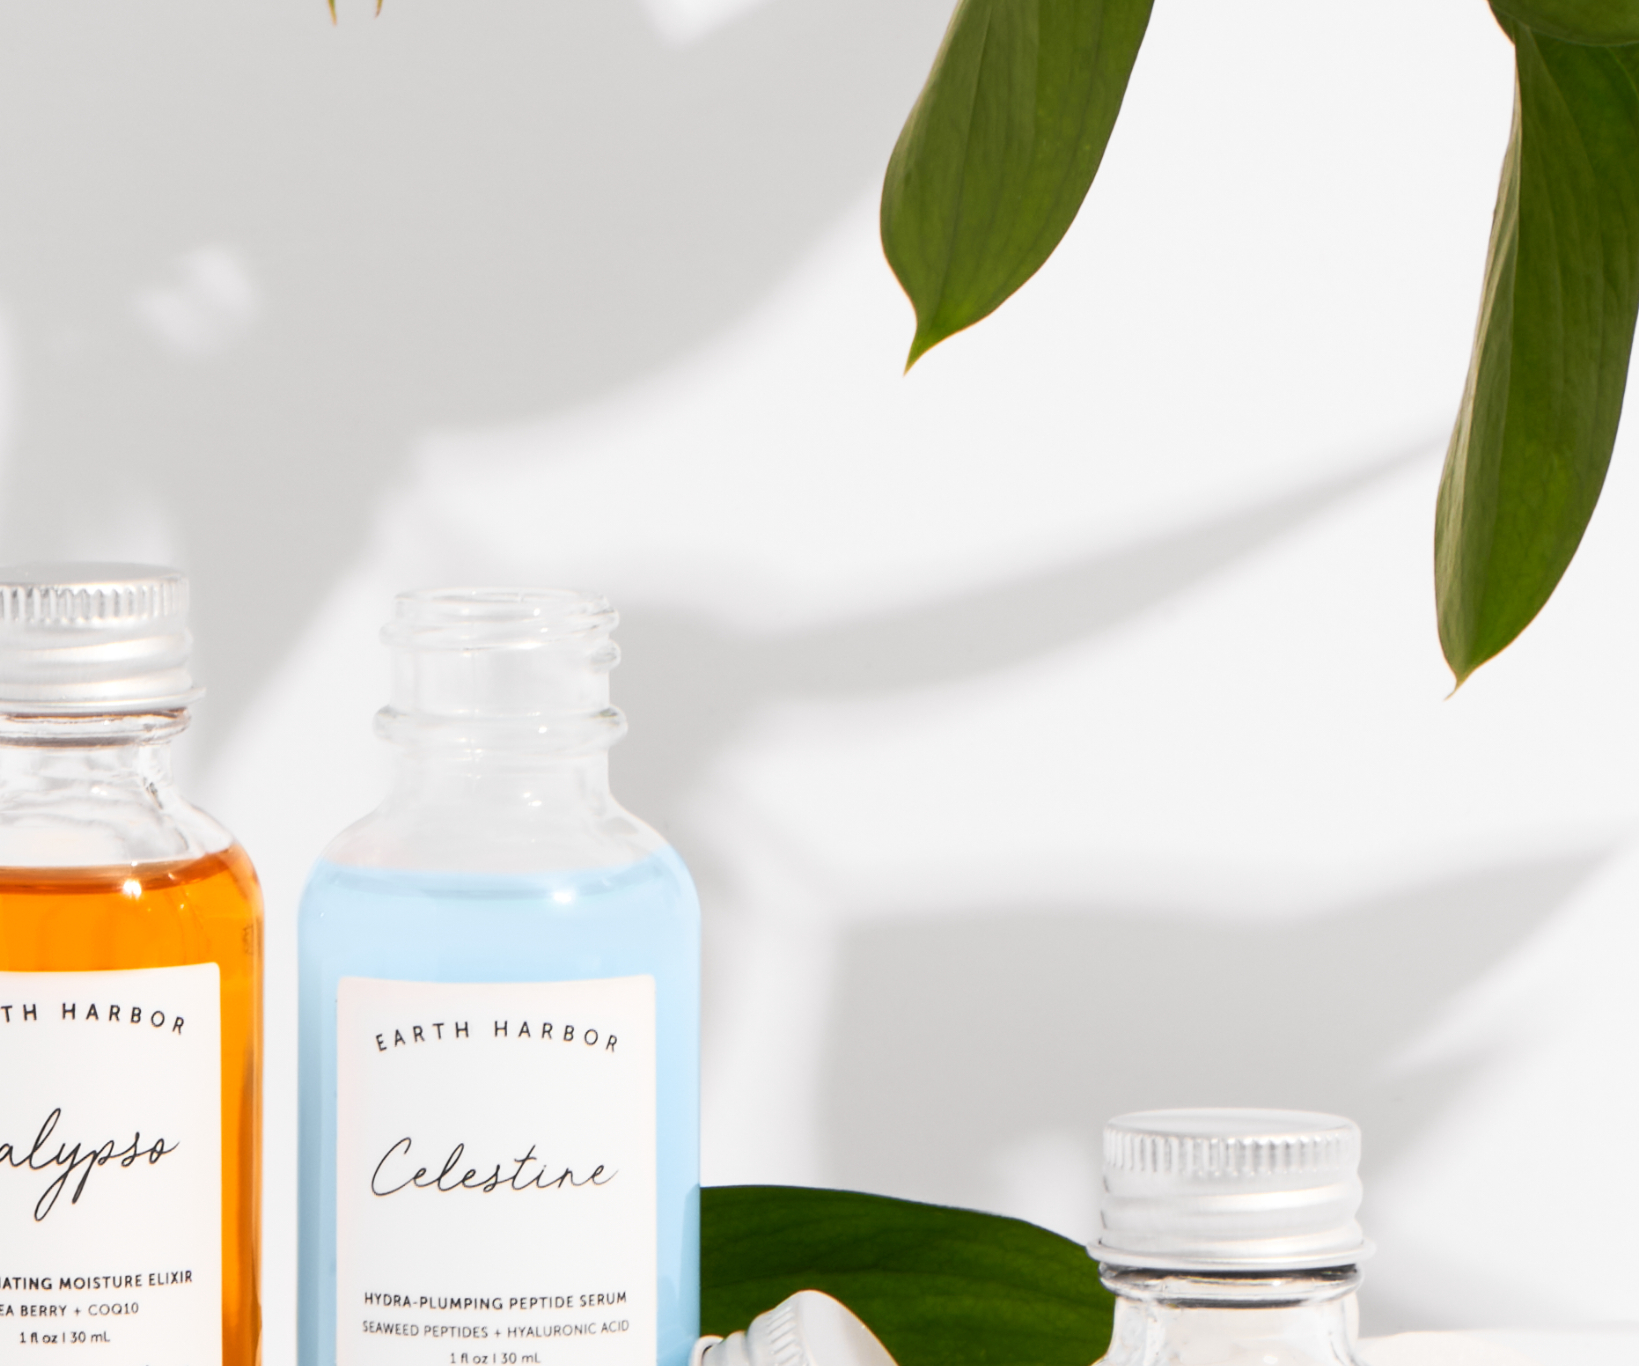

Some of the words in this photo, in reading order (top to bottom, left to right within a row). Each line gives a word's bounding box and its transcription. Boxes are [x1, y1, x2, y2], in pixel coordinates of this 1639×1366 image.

[61, 1002, 185, 1035] HARBOR
[375, 1021, 470, 1052] EARTH
[493, 1020, 618, 1052] HARBOR
[370, 1136, 619, 1197] Celestine
[58, 1273, 142, 1290] MOISTURE
[148, 1269, 193, 1287] ELIXIR
[19, 1304, 67, 1317] BERRY
[74, 1307, 81, 1316] +
[87, 1301, 140, 1317] COQ10
[364, 1292, 504, 1311] HYDRA-PLUMPING
[508, 1295, 573, 1310] PEPTIDE
[579, 1291, 627, 1308] SERUM
[19, 1331, 27, 1345] 1
[29, 1331, 39, 1344] fl
[41, 1334, 58, 1344] oz
[70, 1330, 87, 1344] 30
[90, 1330, 111, 1343] mL
[362, 1319, 420, 1337] SEAWEED
[423, 1324, 489, 1339] PEPTIDES
[494, 1329, 502, 1338] +
[507, 1322, 596, 1338] HYALURONIC
[600, 1319, 630, 1333] ACID
[450, 1352, 457, 1365] 1
[460, 1352, 469, 1364] fl
[472, 1354, 489, 1365] oz
[501, 1351, 518, 1365] 30
[521, 1352, 540, 1364] mL
